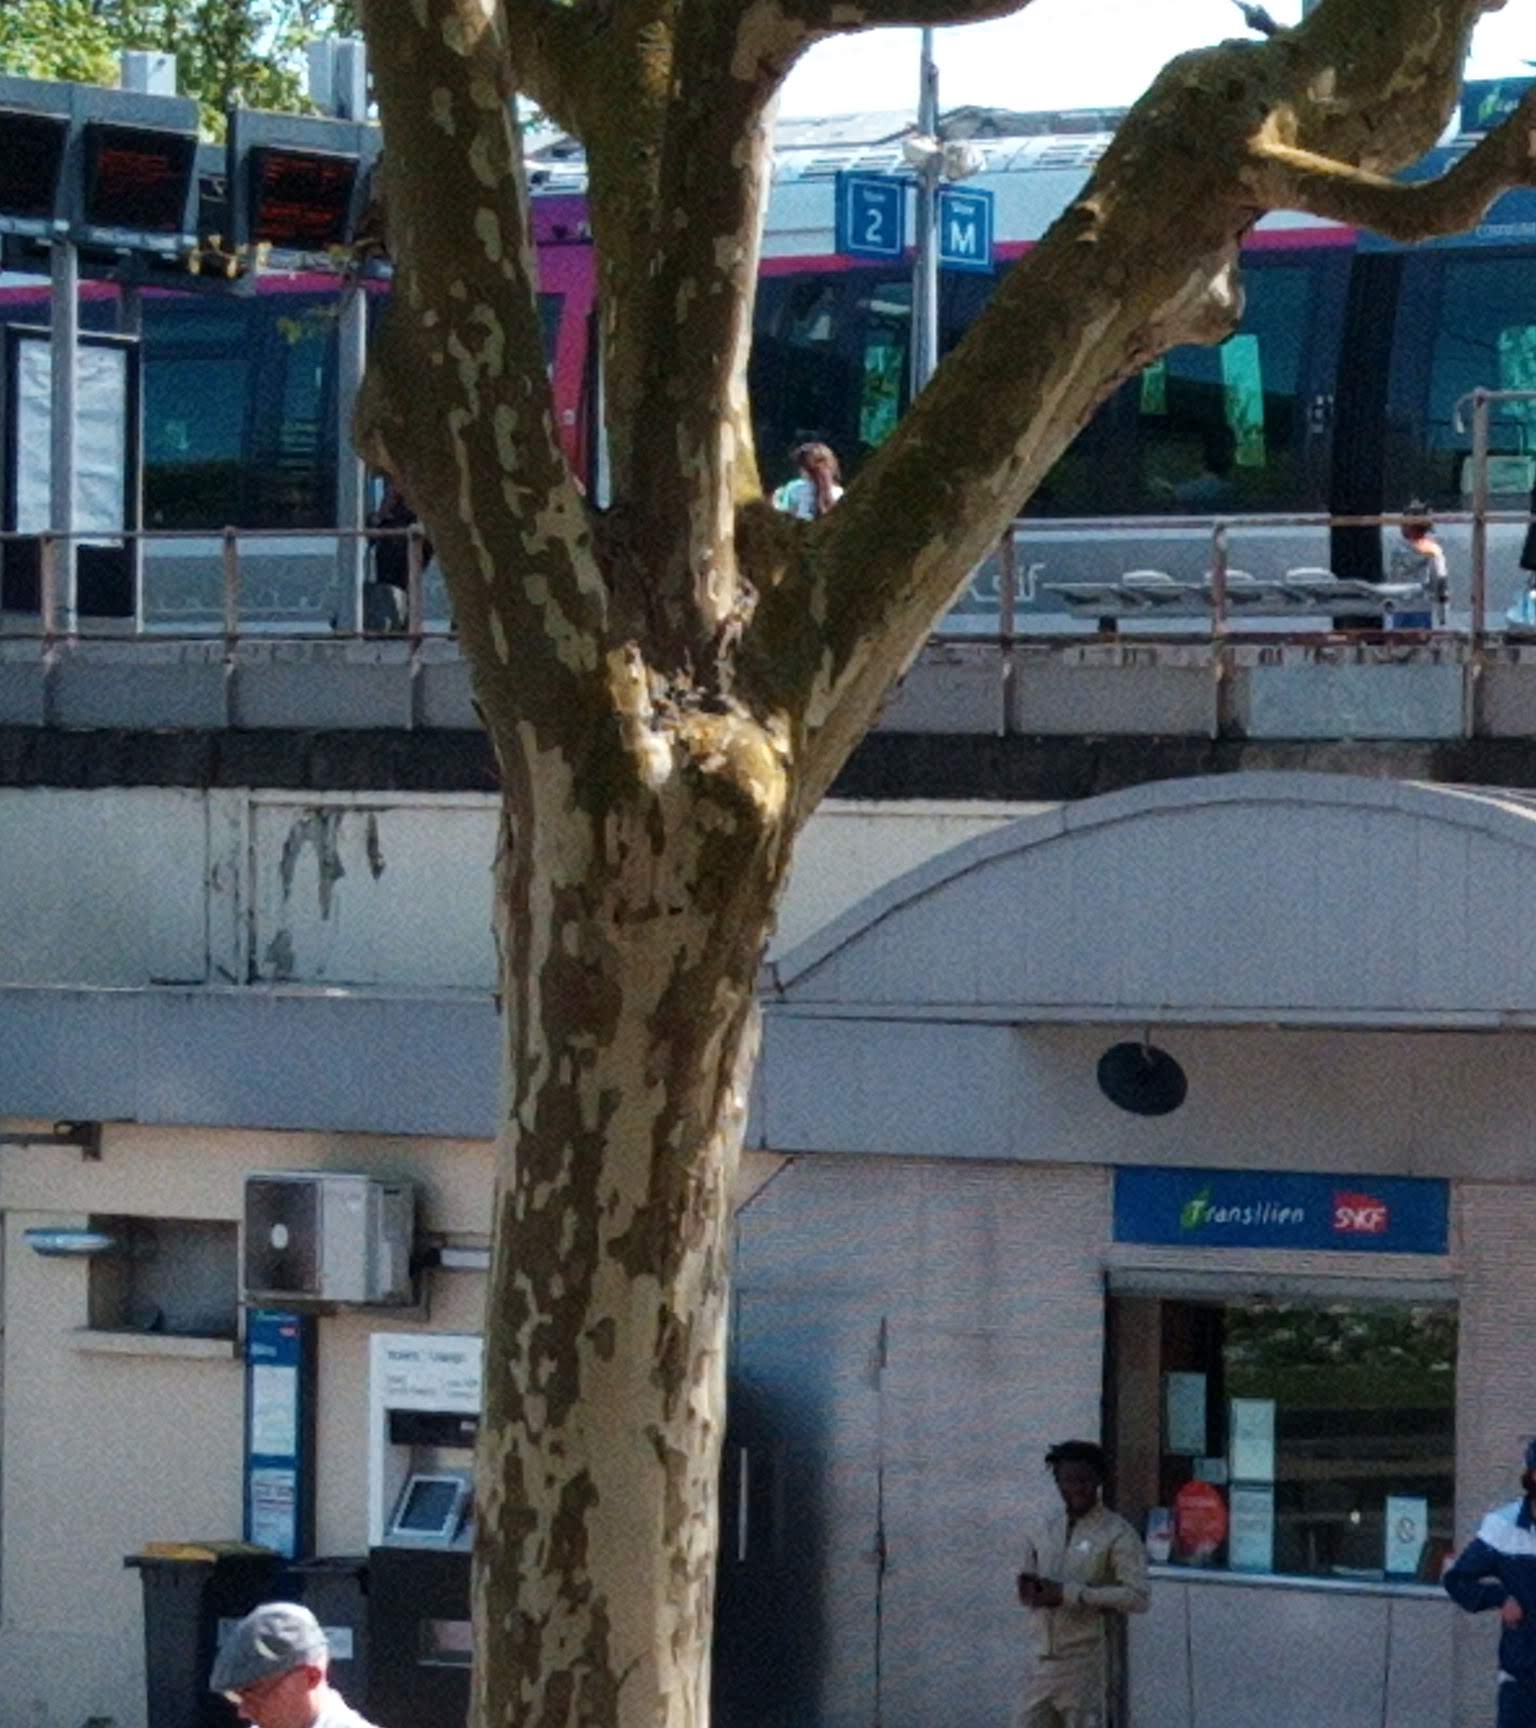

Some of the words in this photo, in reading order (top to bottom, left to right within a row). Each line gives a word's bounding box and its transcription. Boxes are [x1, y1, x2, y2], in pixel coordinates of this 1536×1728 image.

[865, 208, 883, 243] 2
[951, 220, 976, 254] M
[1333, 1206, 1387, 1229] SNCF
